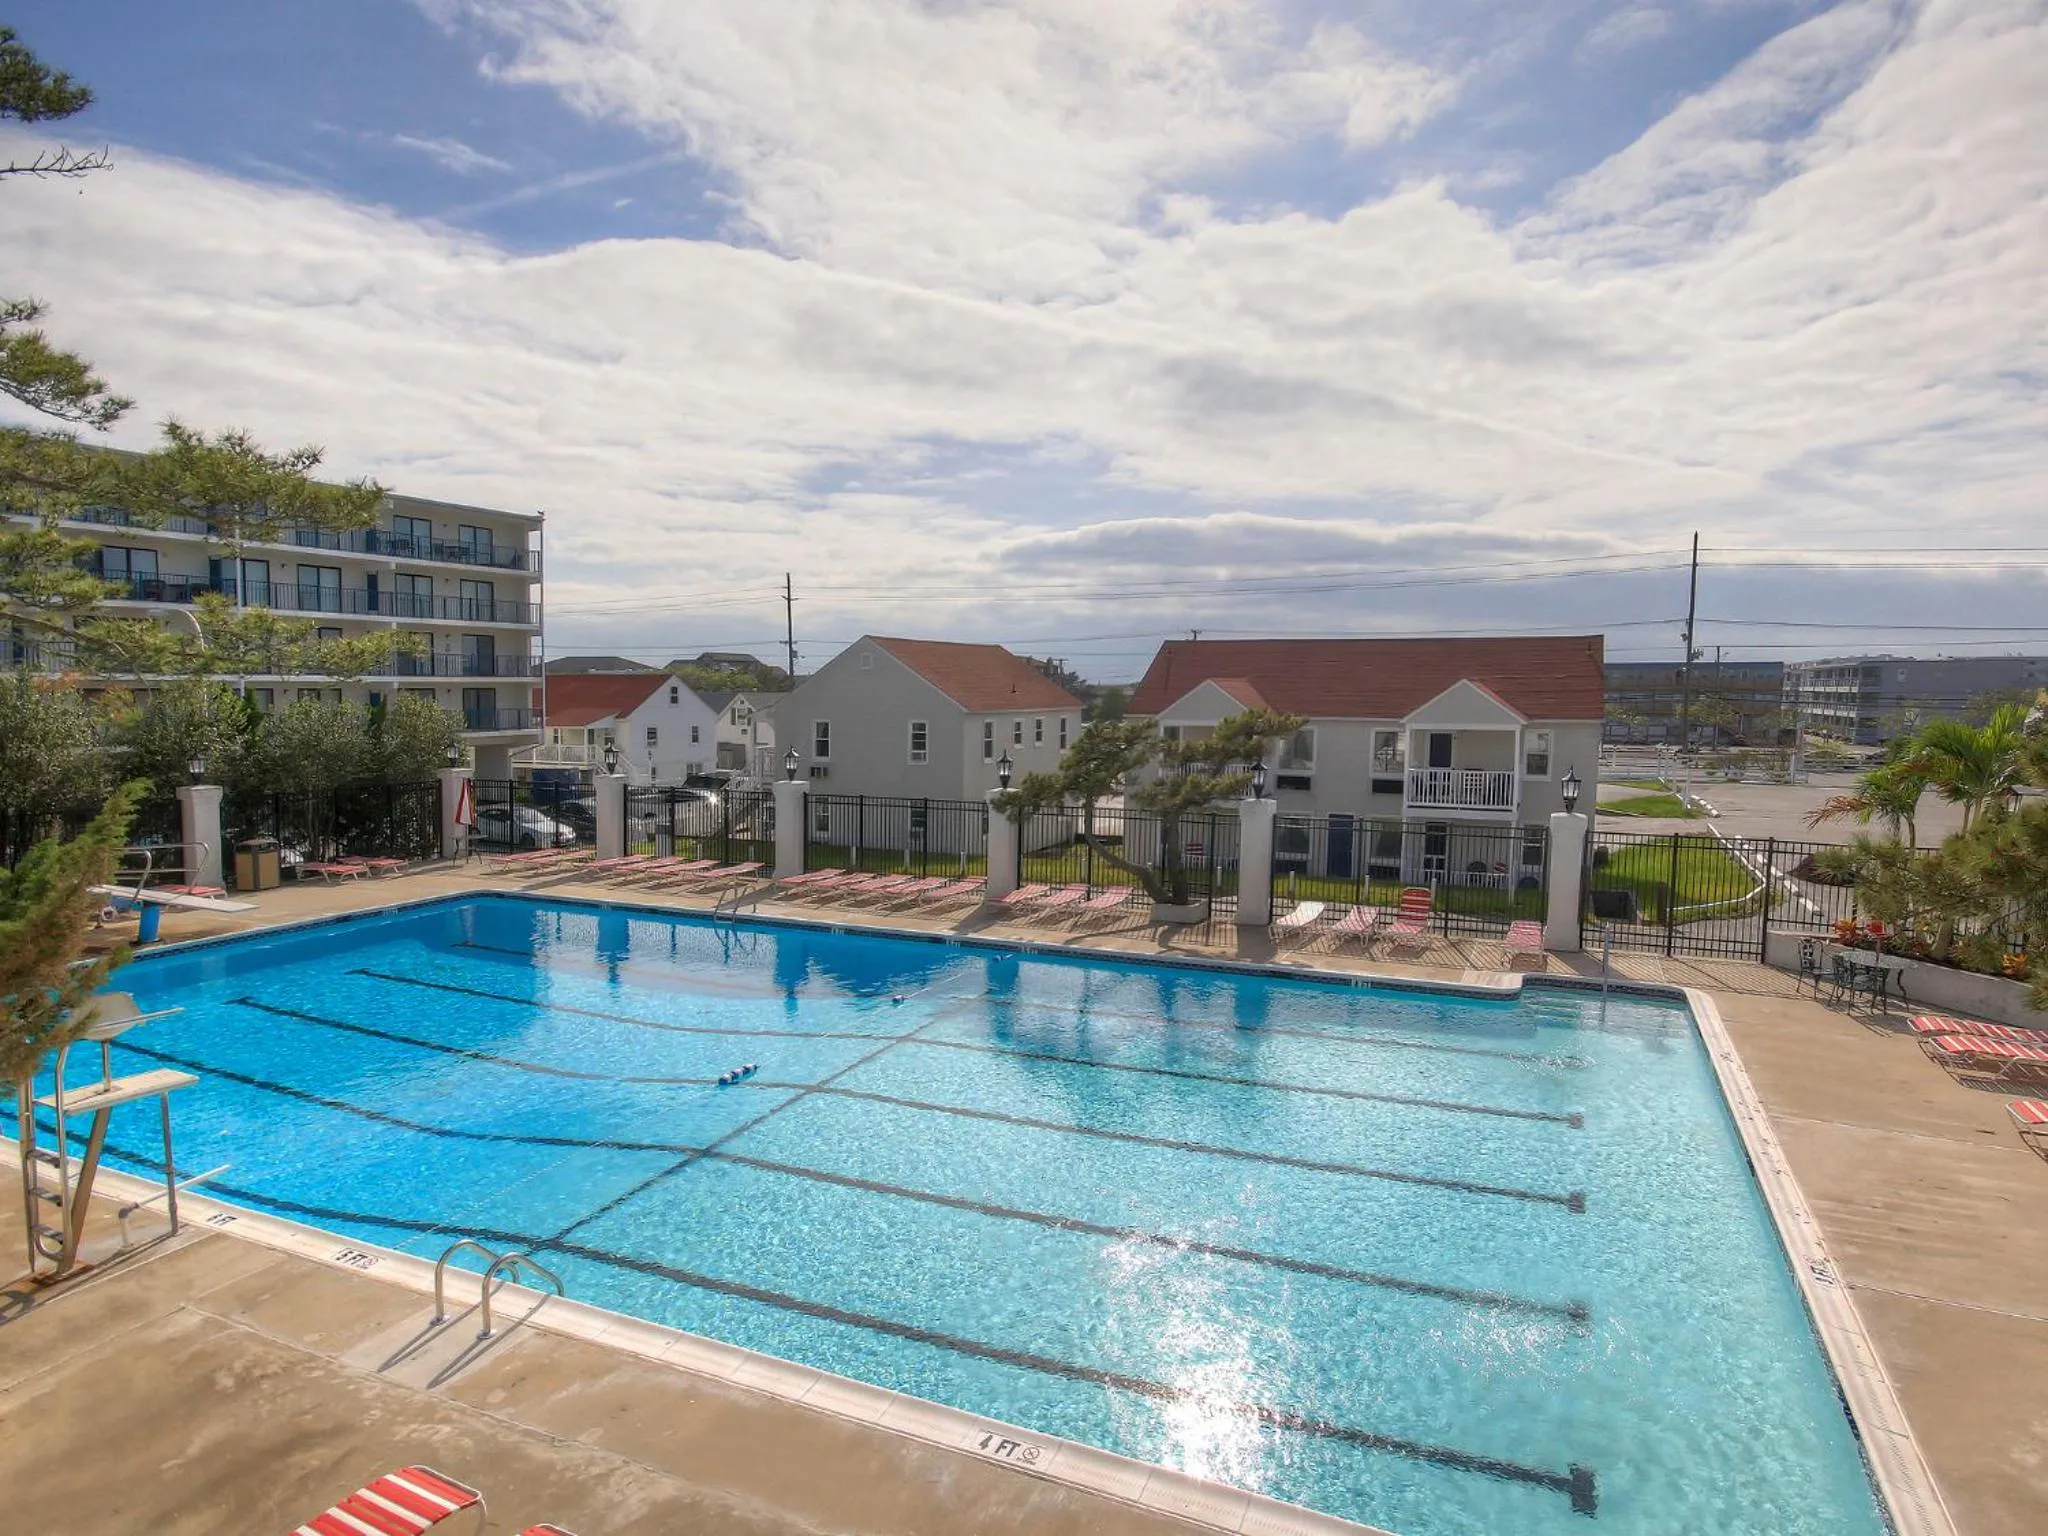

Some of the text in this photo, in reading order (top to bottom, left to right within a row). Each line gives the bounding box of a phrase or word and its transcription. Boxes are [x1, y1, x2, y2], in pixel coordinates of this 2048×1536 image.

[343, 1254, 369, 1265] FT
[978, 1434, 1021, 1457] 4 FT
